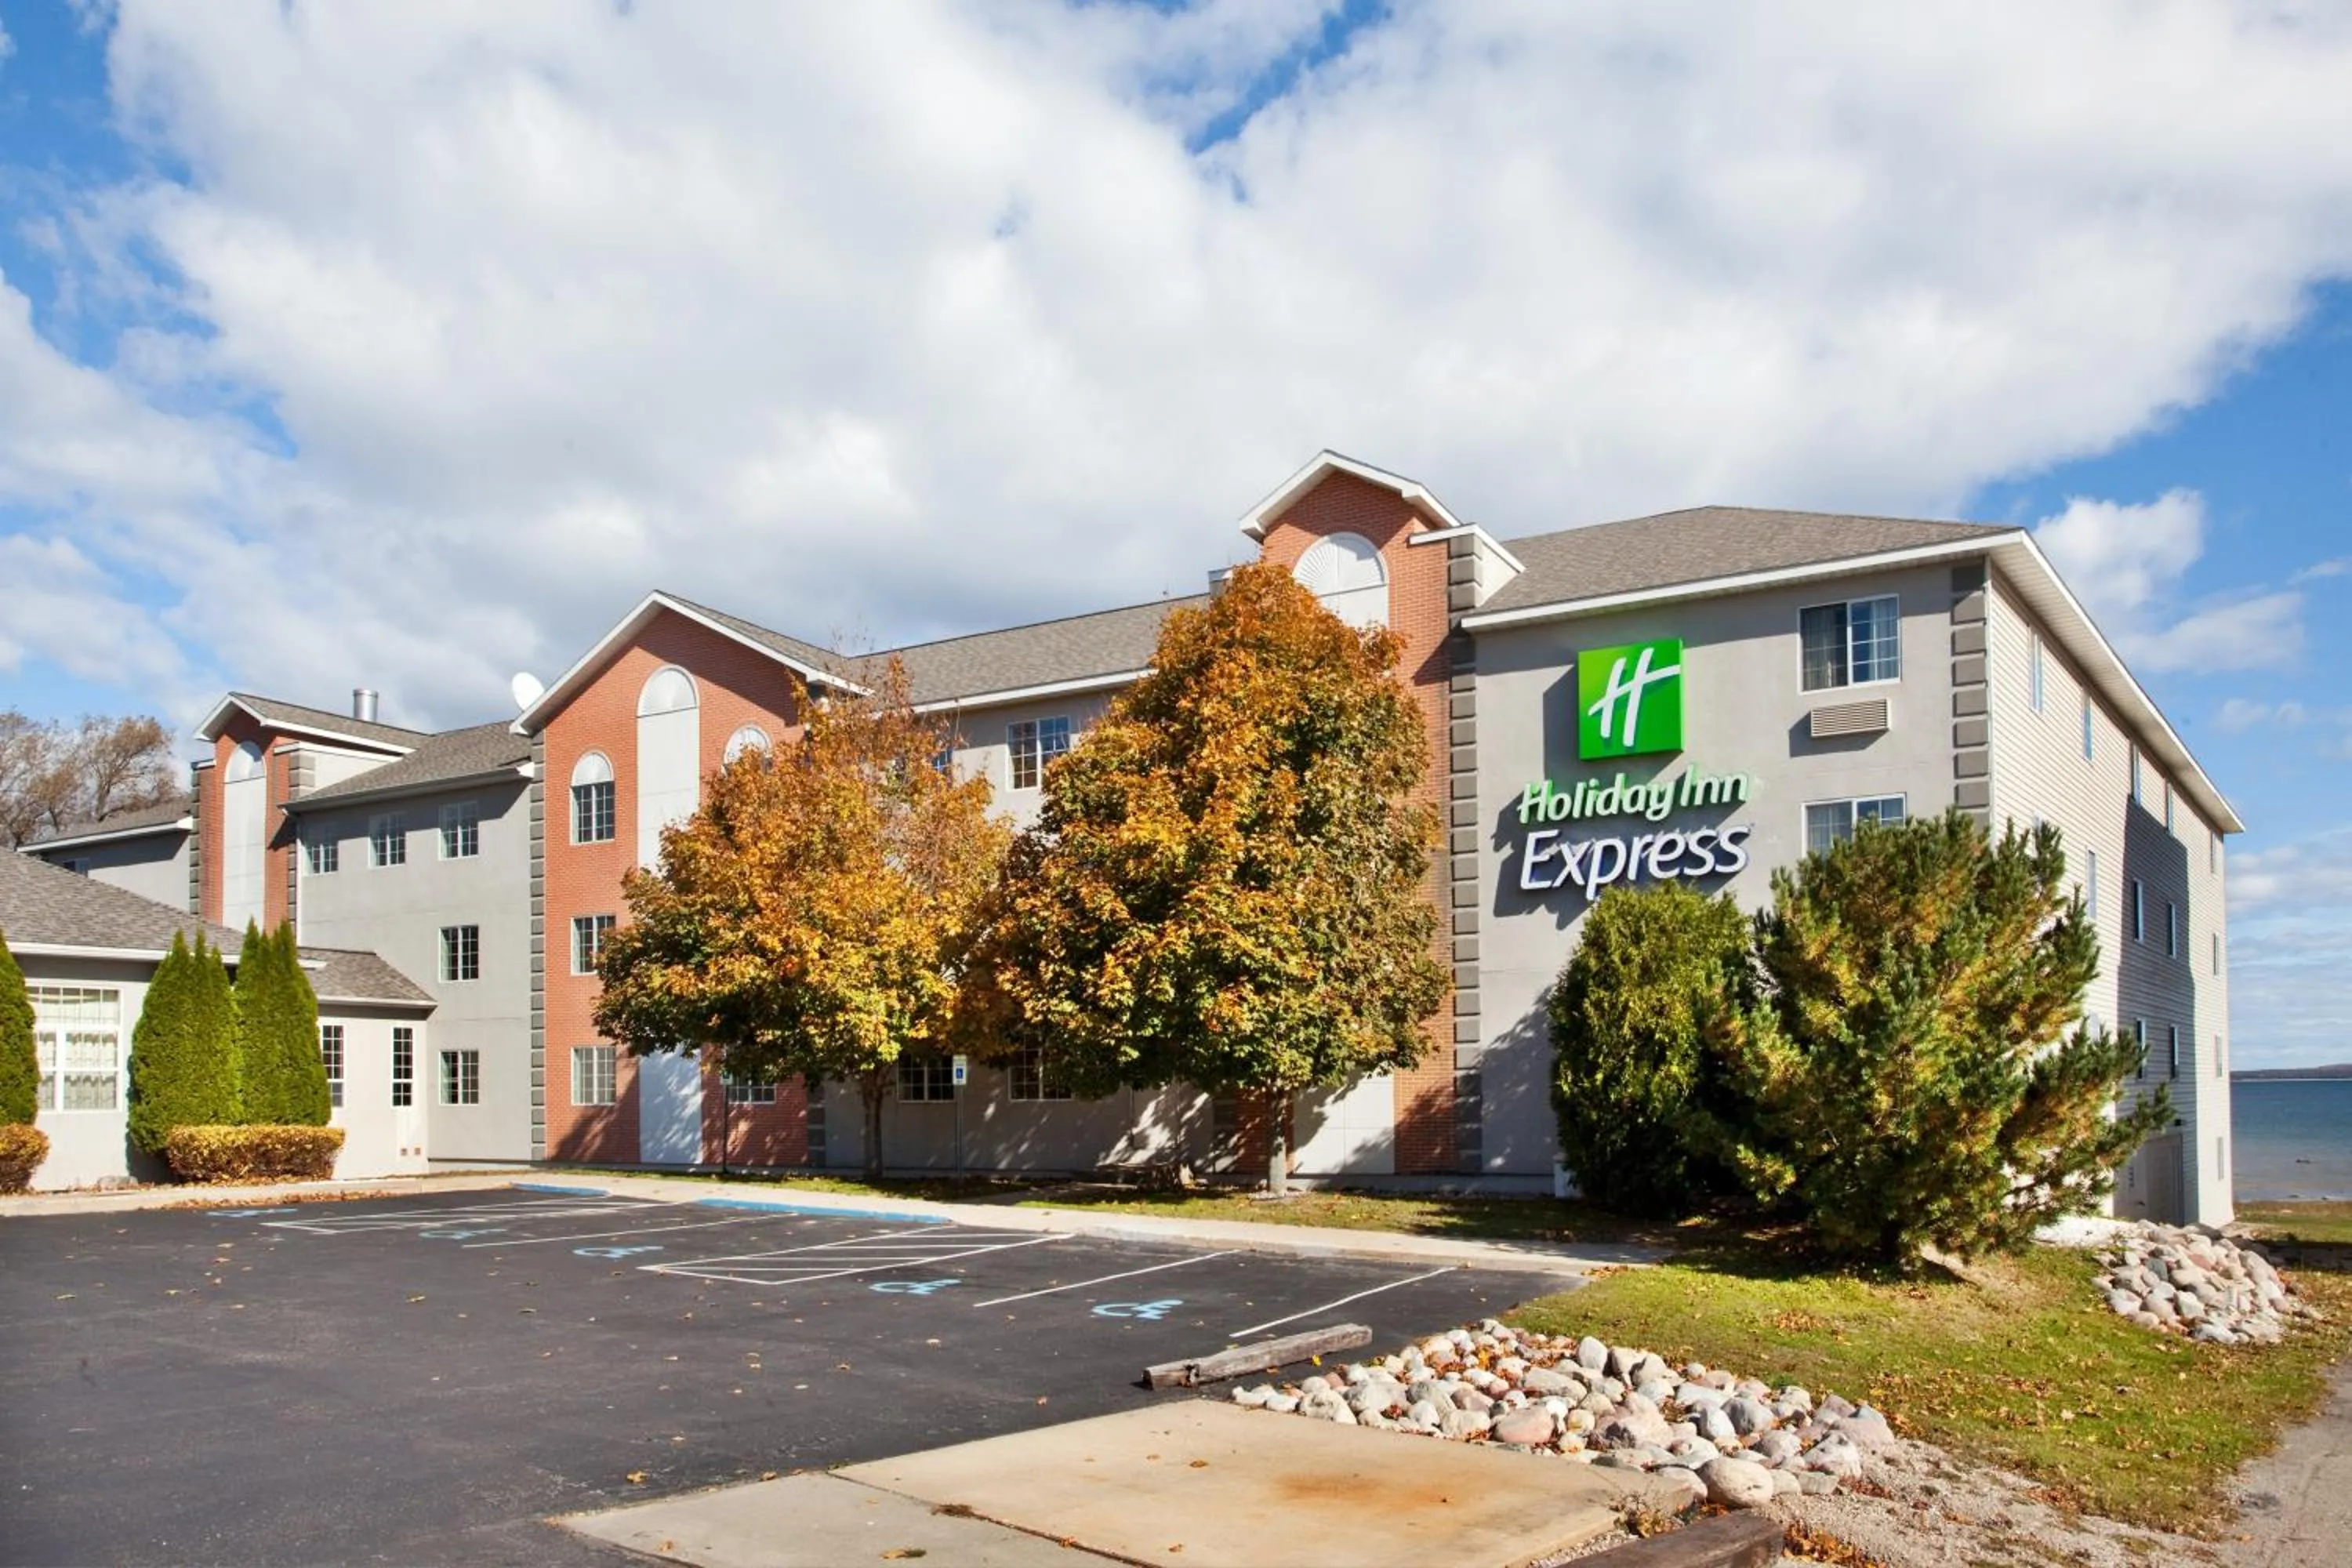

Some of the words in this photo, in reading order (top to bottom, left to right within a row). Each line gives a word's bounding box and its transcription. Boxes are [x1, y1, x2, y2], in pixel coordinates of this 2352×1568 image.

[1588, 647, 1681, 747] H
[1517, 773, 1678, 823] Holiday
[1679, 764, 1748, 808] Inn
[1520, 826, 1751, 902] Express
